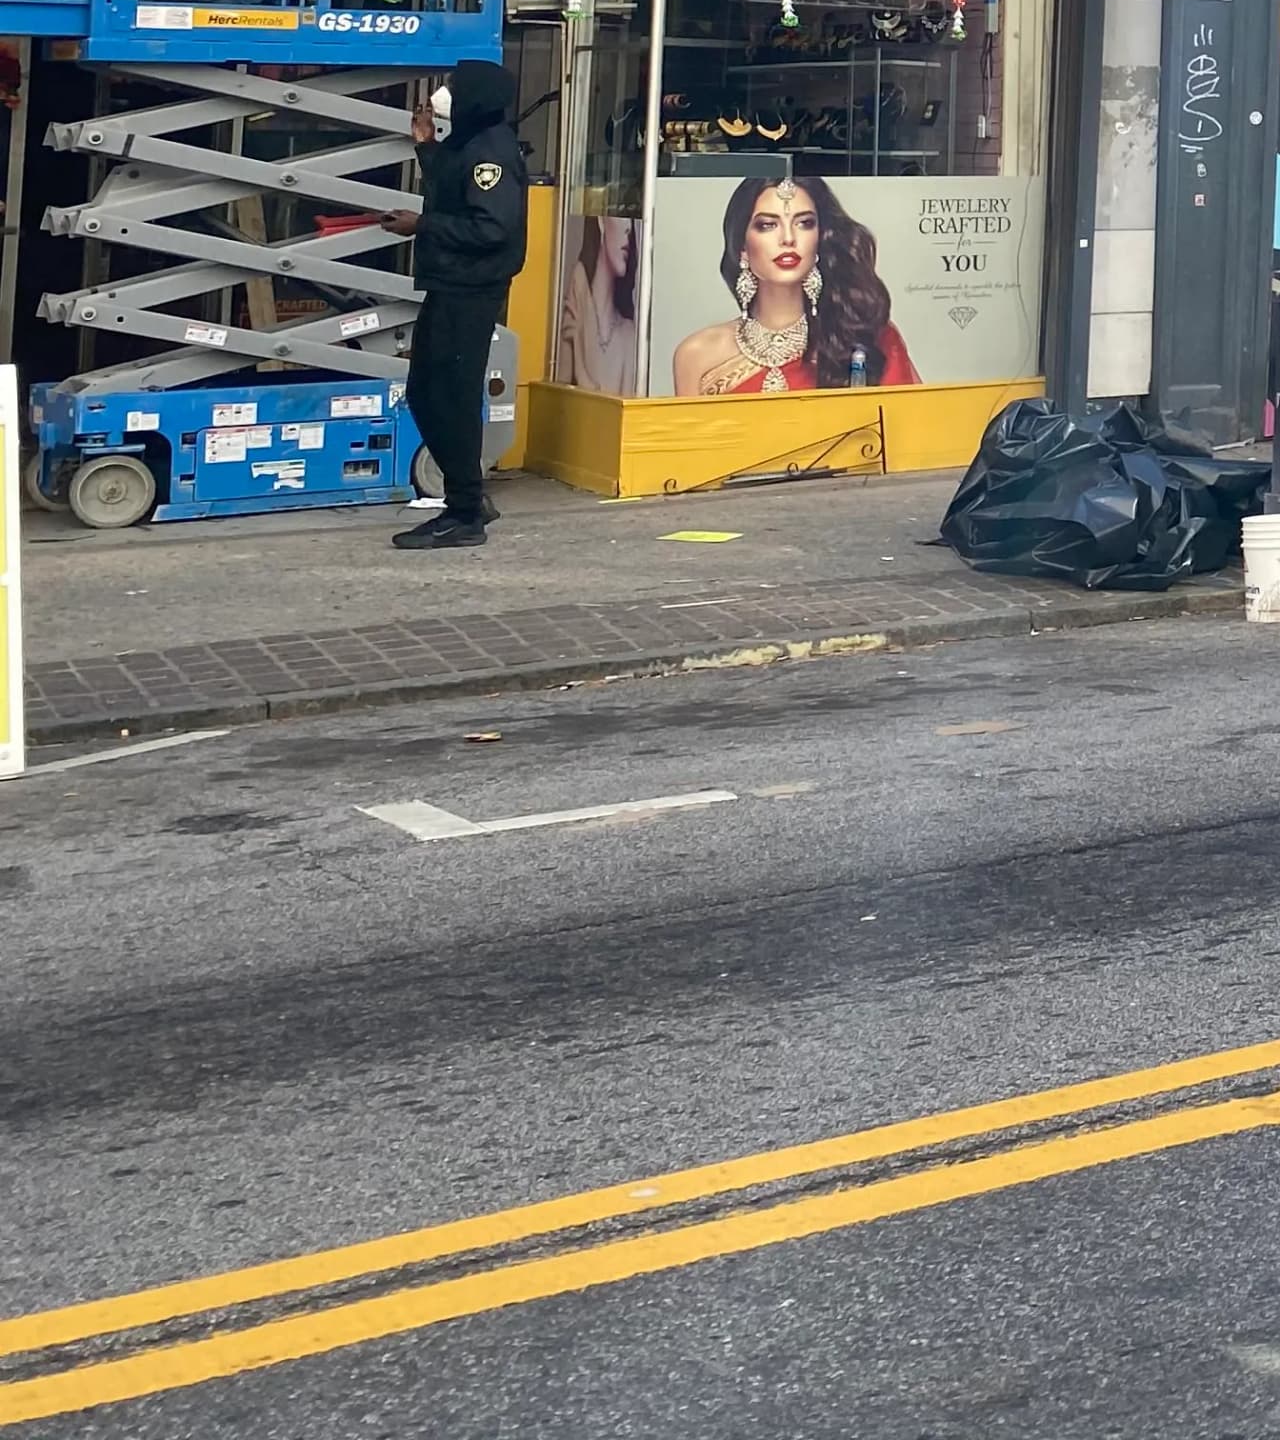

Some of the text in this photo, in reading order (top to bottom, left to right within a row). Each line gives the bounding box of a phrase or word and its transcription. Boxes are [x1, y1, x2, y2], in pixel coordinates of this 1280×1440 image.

[318, 12, 420, 35] GS-1930
[918, 197, 1012, 217] JEWELERY
[918, 215, 1012, 235] CRAFTED
[940, 253, 988, 273] YOU
